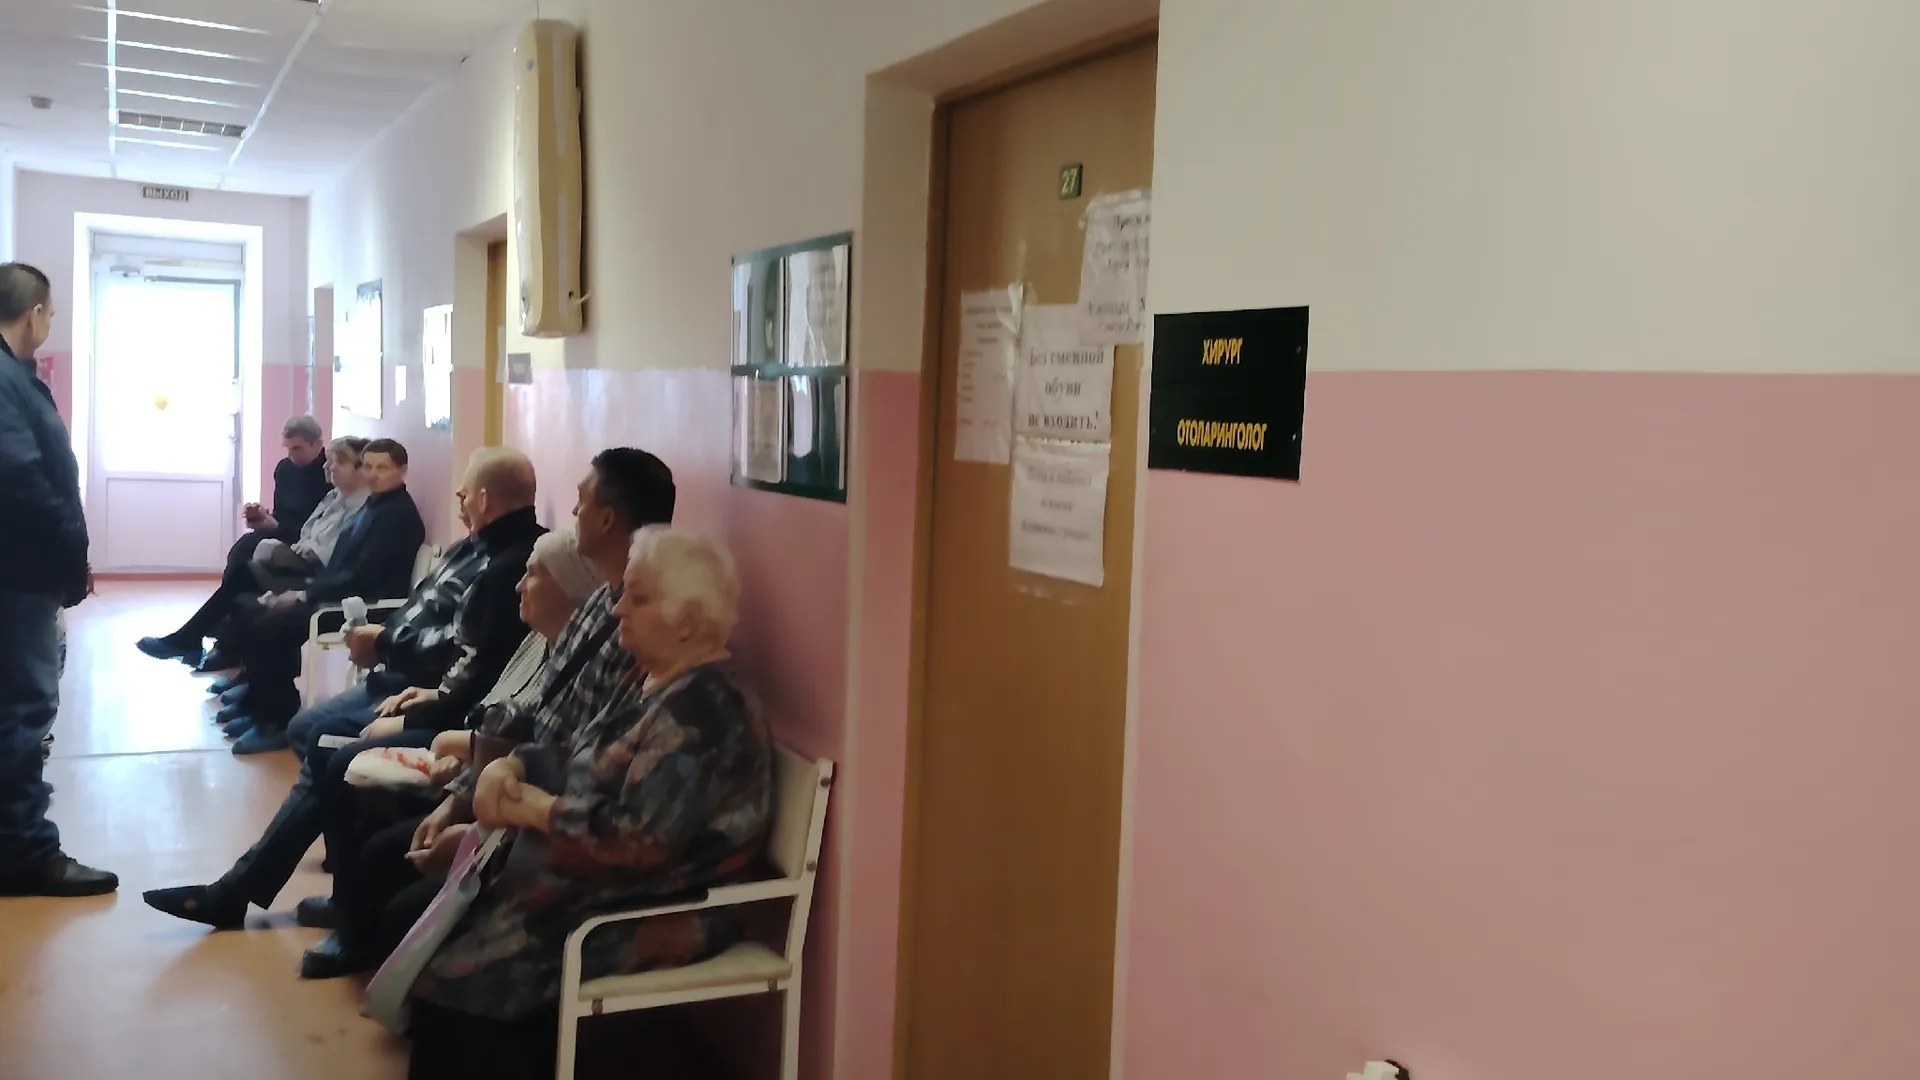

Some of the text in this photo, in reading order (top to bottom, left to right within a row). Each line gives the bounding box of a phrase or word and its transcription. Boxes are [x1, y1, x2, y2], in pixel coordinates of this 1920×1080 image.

[145, 188, 187, 200] ВЫХОД
[1061, 168, 1078, 195] 27
[1202, 337, 1244, 366] ХИРУРГ
[1044, 376, 1082, 401] обуви
[1028, 410, 1099, 431] не входить!
[1177, 418, 1268, 451] ОТОЛАРИНГОЛОГ
